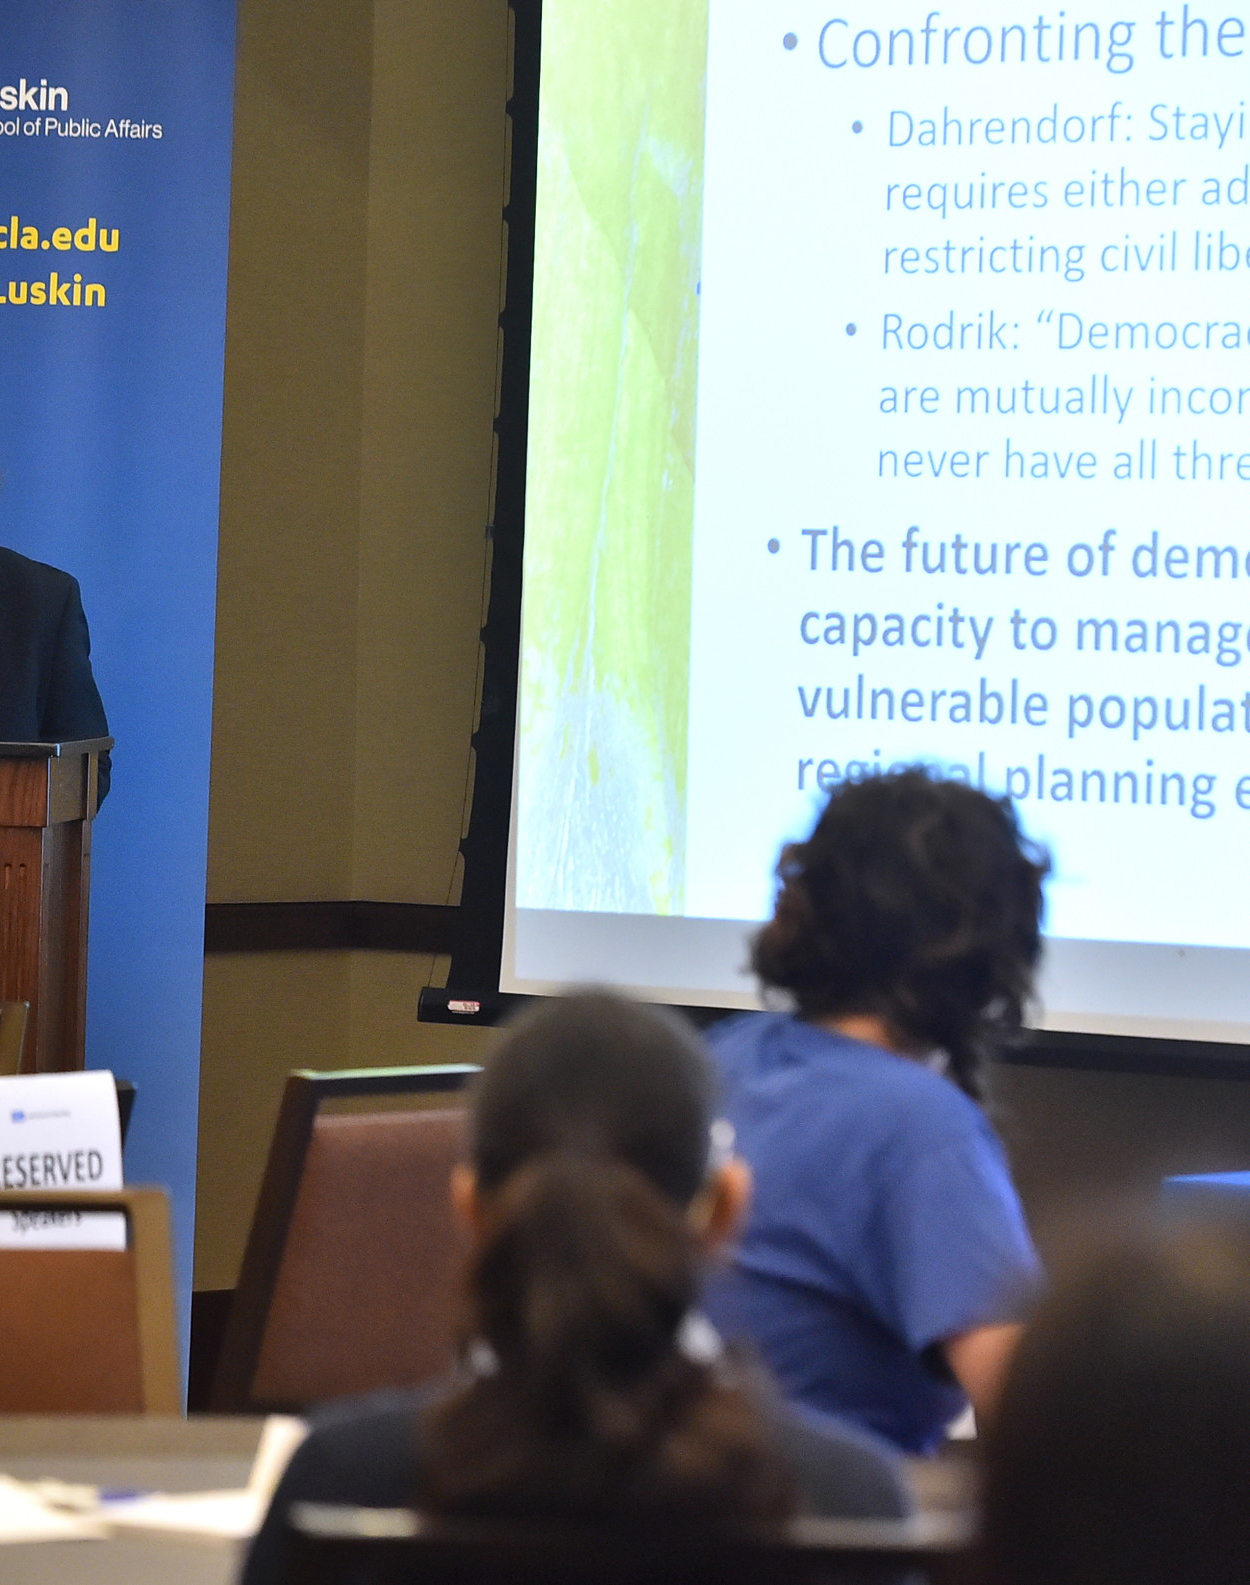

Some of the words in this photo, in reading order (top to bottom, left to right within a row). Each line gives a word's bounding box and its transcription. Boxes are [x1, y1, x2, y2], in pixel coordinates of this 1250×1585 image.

[818, 10, 1137, 75] Confronting
[1154, 2, 1246, 60] the
[23, 117, 42, 136] of
[44, 117, 101, 138] Public
[104, 118, 163, 139] Affairs
[888, 100, 1132, 148] Dahrendorf:
[1148, 100, 1245, 150] Stayi
[886, 171, 1049, 220] requires
[1063, 165, 1188, 209] either
[1201, 162, 1250, 206] ad
[884, 234, 1087, 283] restricting
[1100, 230, 1177, 273] civil
[1194, 229, 1250, 272] lib
[882, 309, 1019, 351] Rodrik:
[1036, 308, 1250, 350] “Democra
[879, 386, 940, 414] are
[956, 373, 1134, 425] mutually
[878, 449, 991, 479] never
[1004, 437, 1098, 480] have
[1113, 438, 1157, 480] all
[1172, 439, 1250, 481] thre
[800, 524, 886, 574] The
[901, 524, 1050, 577] future
[1066, 527, 1118, 578] of
[1131, 529, 1250, 580] dem
[799, 601, 995, 661] capacity
[1009, 607, 1059, 652] to
[1076, 617, 1250, 668] manag
[796, 672, 1050, 727] vulnerable
[1006, 753, 1217, 819] planning
